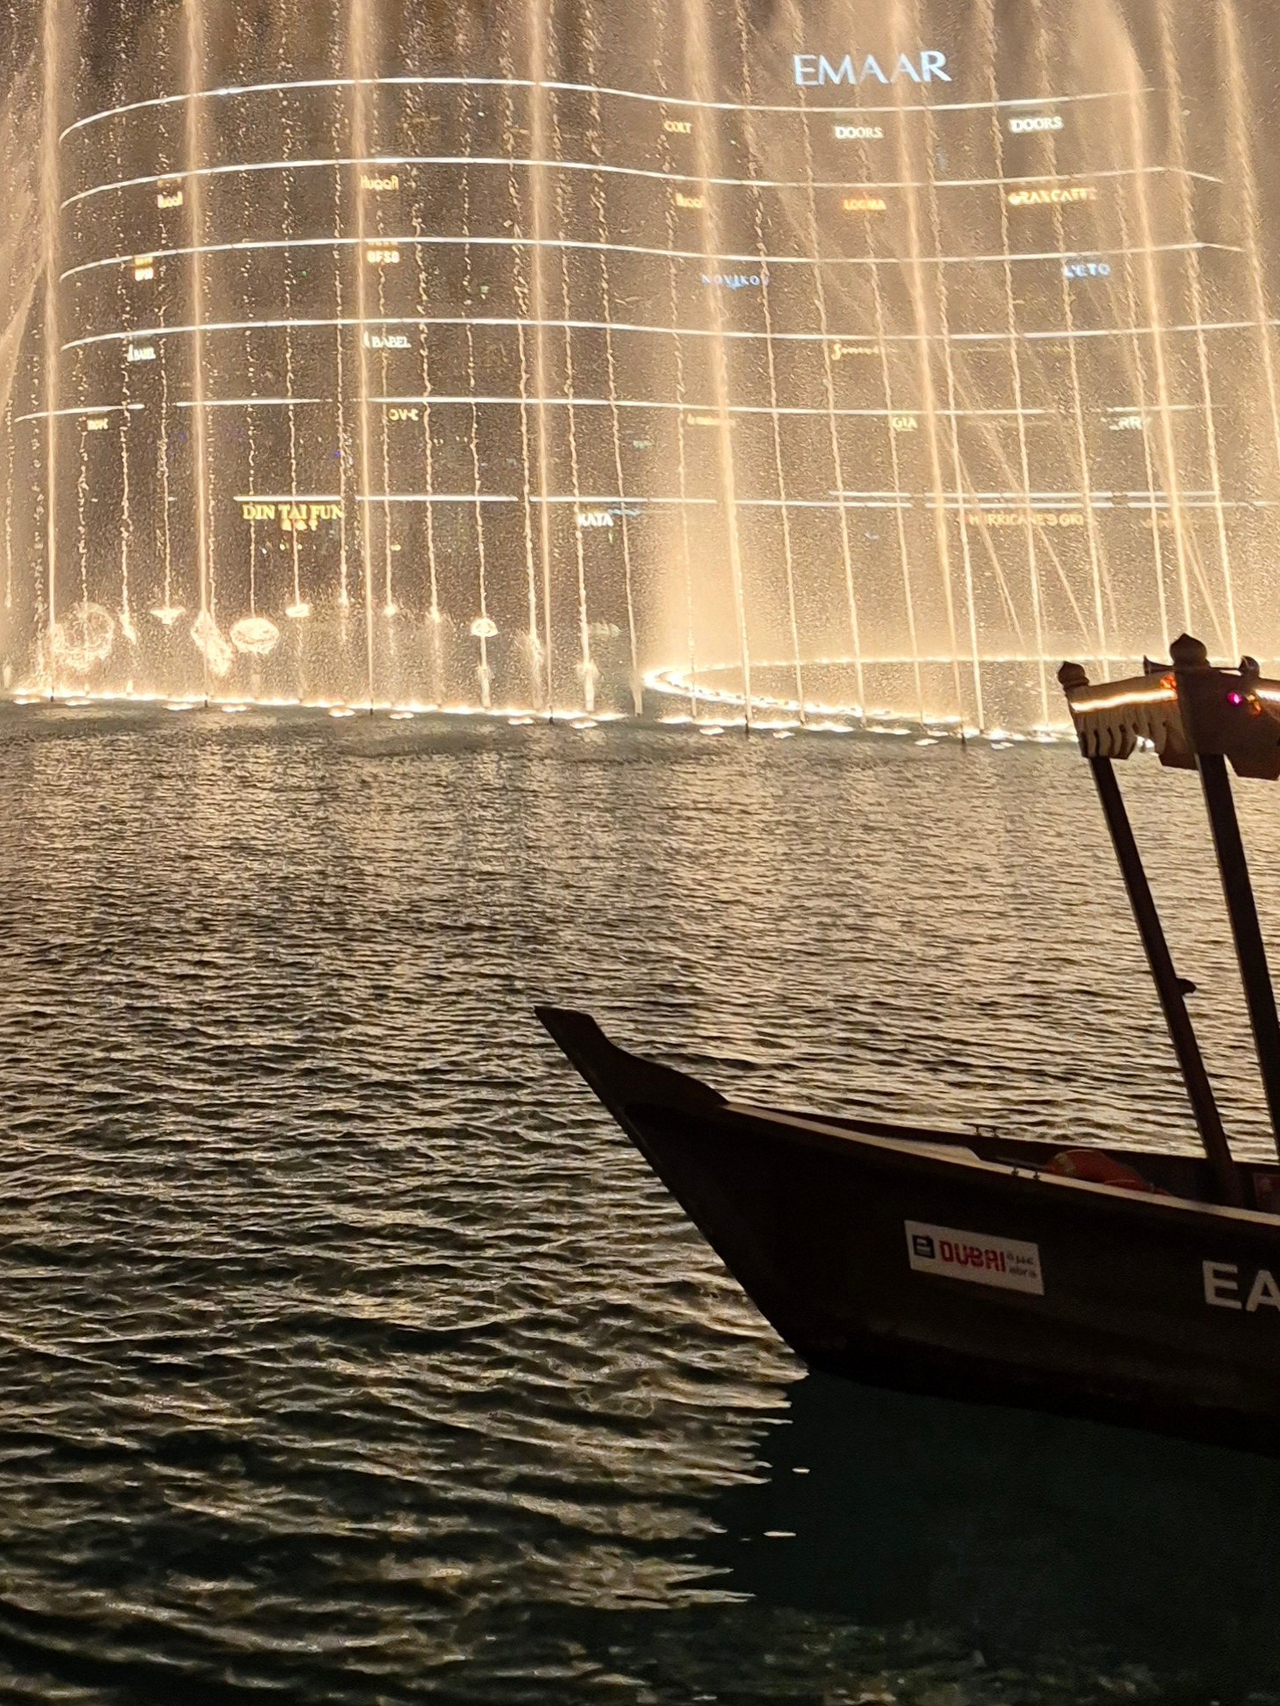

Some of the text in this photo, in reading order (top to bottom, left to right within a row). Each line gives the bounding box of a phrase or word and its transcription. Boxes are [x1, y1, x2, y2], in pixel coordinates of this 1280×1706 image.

[793, 50, 953, 86] EMAAR
[835, 126, 884, 139] DOORS
[1009, 115, 1064, 134] DOORS
[372, 335, 412, 349] BABEL
[242, 504, 275, 520] DIN
[278, 504, 308, 520] TAI
[938, 1239, 1006, 1273] DUBAI
[1202, 1260, 1280, 1313] EA
